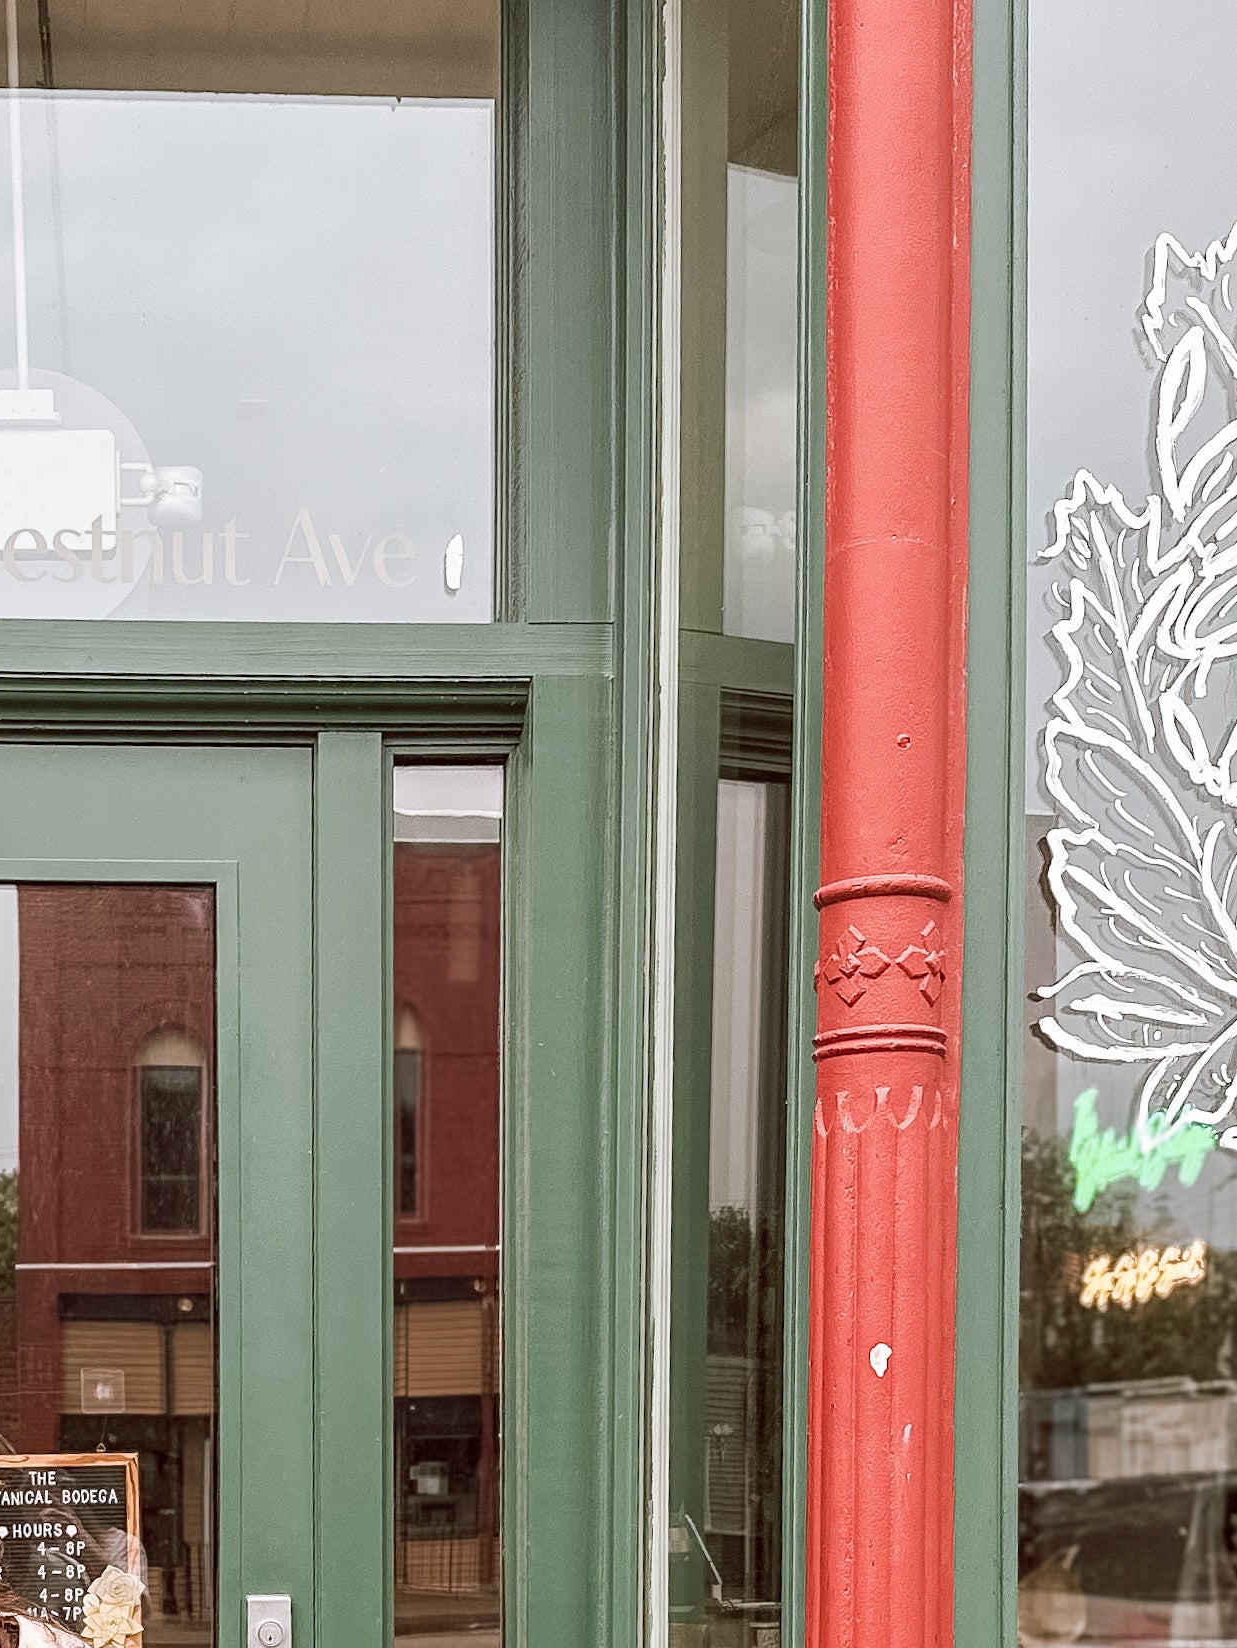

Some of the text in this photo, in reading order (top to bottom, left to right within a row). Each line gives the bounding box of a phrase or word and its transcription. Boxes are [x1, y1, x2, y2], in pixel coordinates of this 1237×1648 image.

[272, 507, 417, 588] Ave
[28, 1470, 57, 1487] THE
[61, 1488, 119, 1505] BODEGA
[12, 1522, 63, 1539] HOURS
